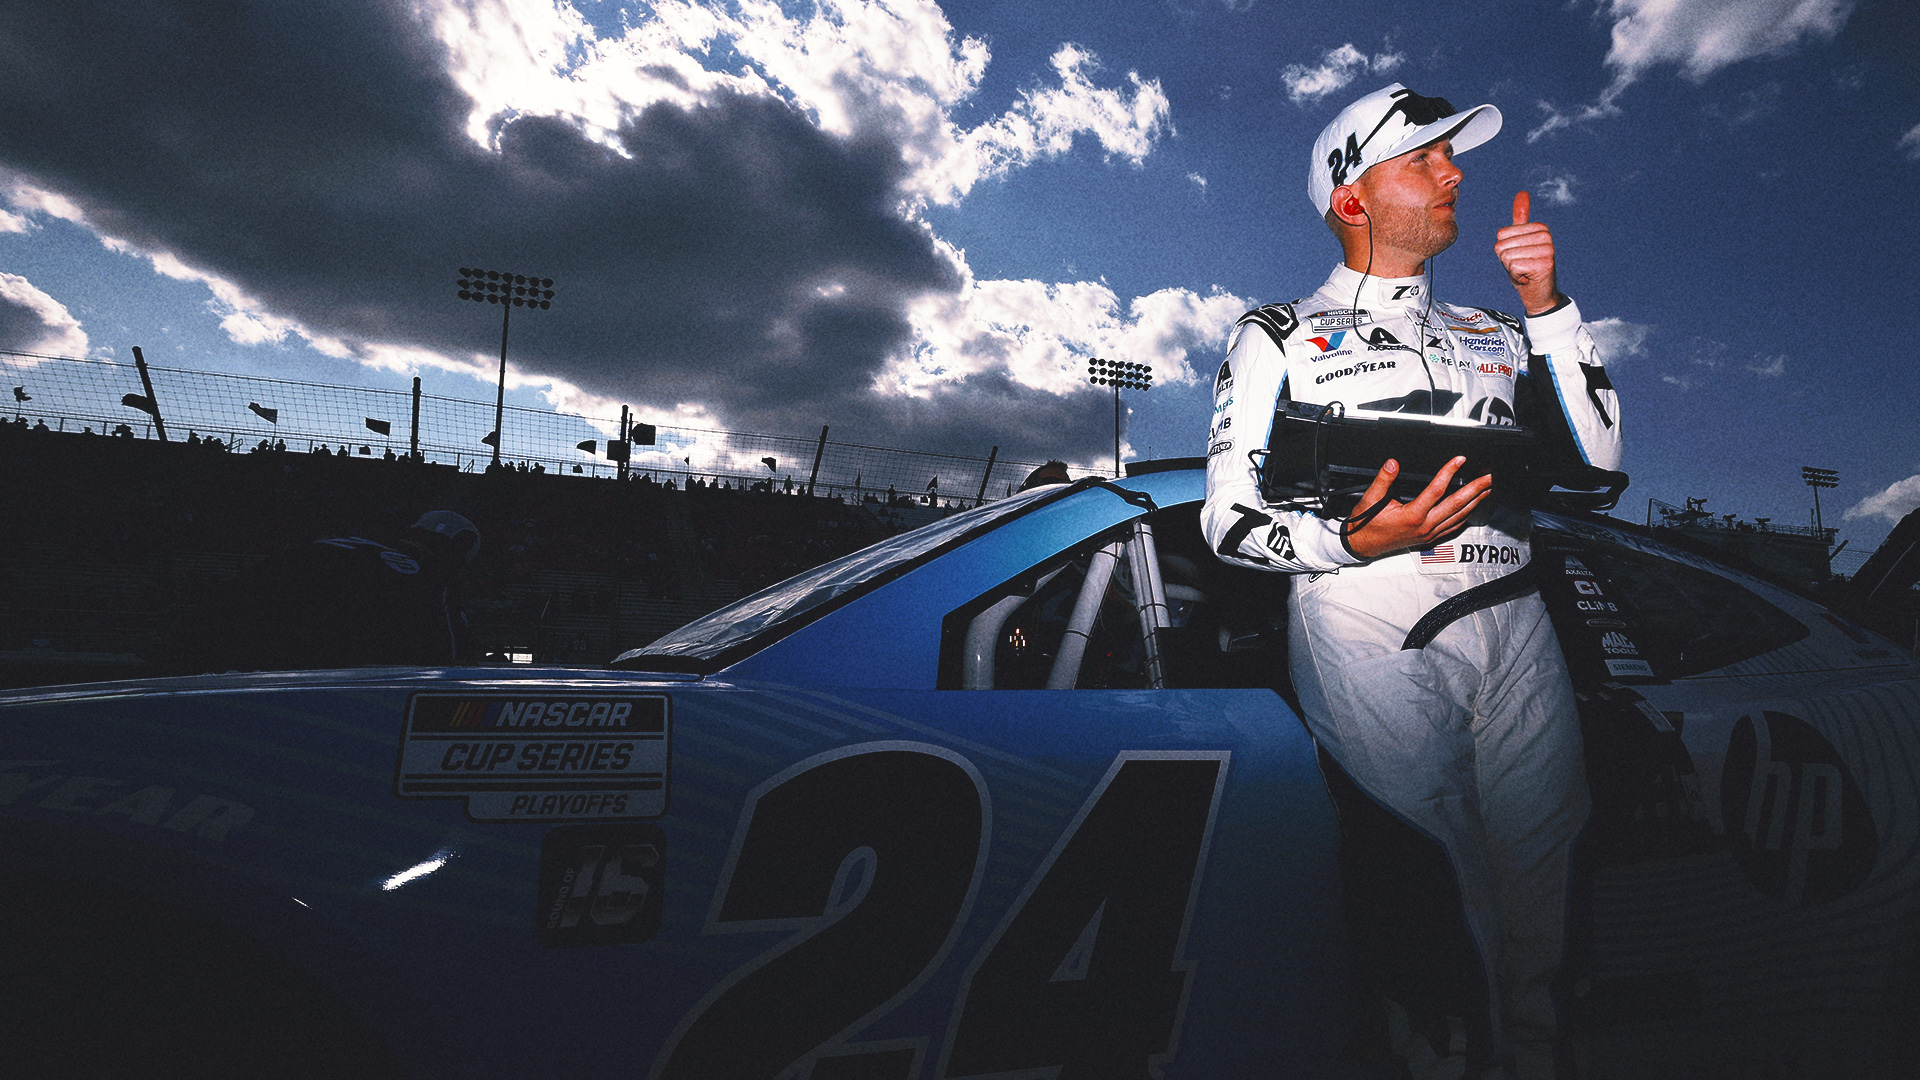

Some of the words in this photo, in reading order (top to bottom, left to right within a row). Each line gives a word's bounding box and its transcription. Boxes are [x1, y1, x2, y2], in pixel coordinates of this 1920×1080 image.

[1328, 132, 1362, 187] 24
[1339, 317, 1363, 325] SERIES
[1460, 336, 1505, 347] Hendrick
[1469, 345, 1505, 354] Cars.com
[1310, 349, 1353, 362] Valvoline
[1315, 361, 1396, 385] GOODYEAR
[1459, 544, 1521, 565] BYRON
[1602, 631, 1636, 648] MAC
[1604, 647, 1639, 655] TOOLS
[1612, 663, 1648, 671] SIEMENS
[496, 702, 632, 726] NASCAR
[440, 743, 516, 771] CUP
[516, 742, 635, 771] SERIES
[510, 794, 629, 816] PLAYOFFS
[648, 740, 1231, 1080] 24
